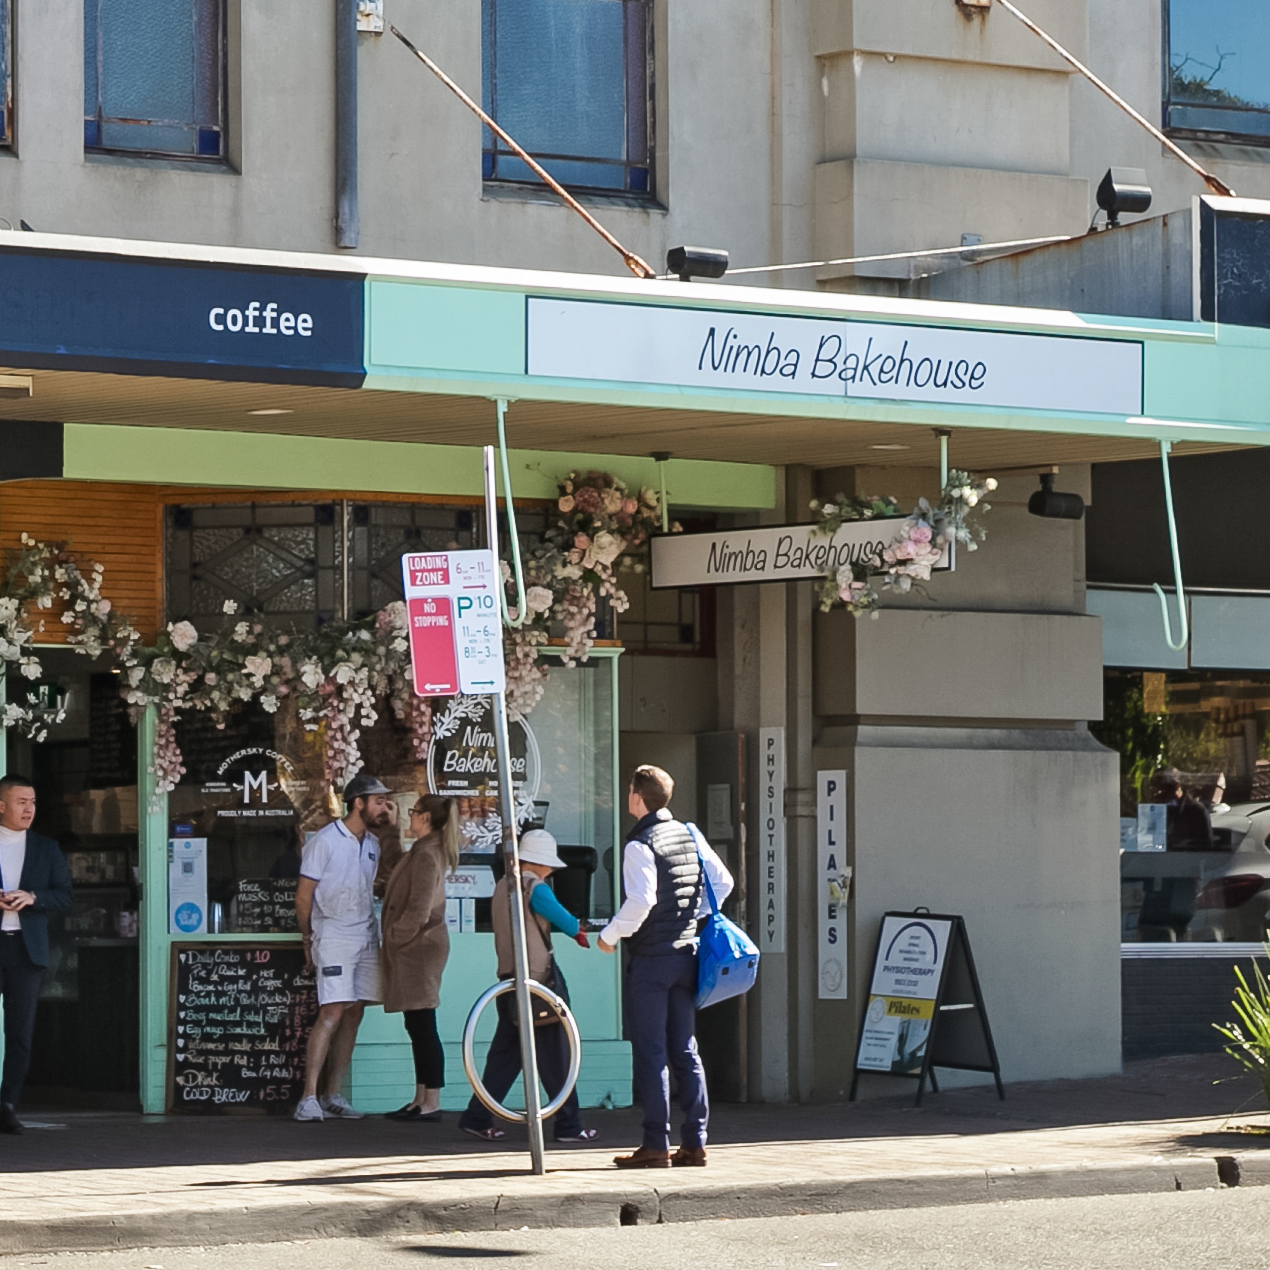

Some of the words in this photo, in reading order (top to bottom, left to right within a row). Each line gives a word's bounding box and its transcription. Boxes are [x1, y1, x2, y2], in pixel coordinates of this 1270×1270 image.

[209, 301, 313, 337] coffee
[698, 327, 801, 380] Nimba
[811, 334, 987, 390] Bakehouse
[409, 556, 448, 570] LOADING
[707, 539, 767, 574] Nimba
[415, 571, 445, 585] ZONE
[423, 603, 437, 613] NO
[457, 596, 473, 618] P
[414, 615, 449, 627] STOPPING
[462, 725, 496, 748] Nim
[216, 747, 264, 776] MOTHERSKY
[243, 770, 268, 803] M
[766, 737, 776, 944] PHYSIOTHERAPY
[883, 965, 935, 976] PHYSIOTHERAPY
[888, 1000, 921, 1015] Pilates
[183, 1087, 211, 1101] COLD
[212, 1087, 251, 1103] BREW
